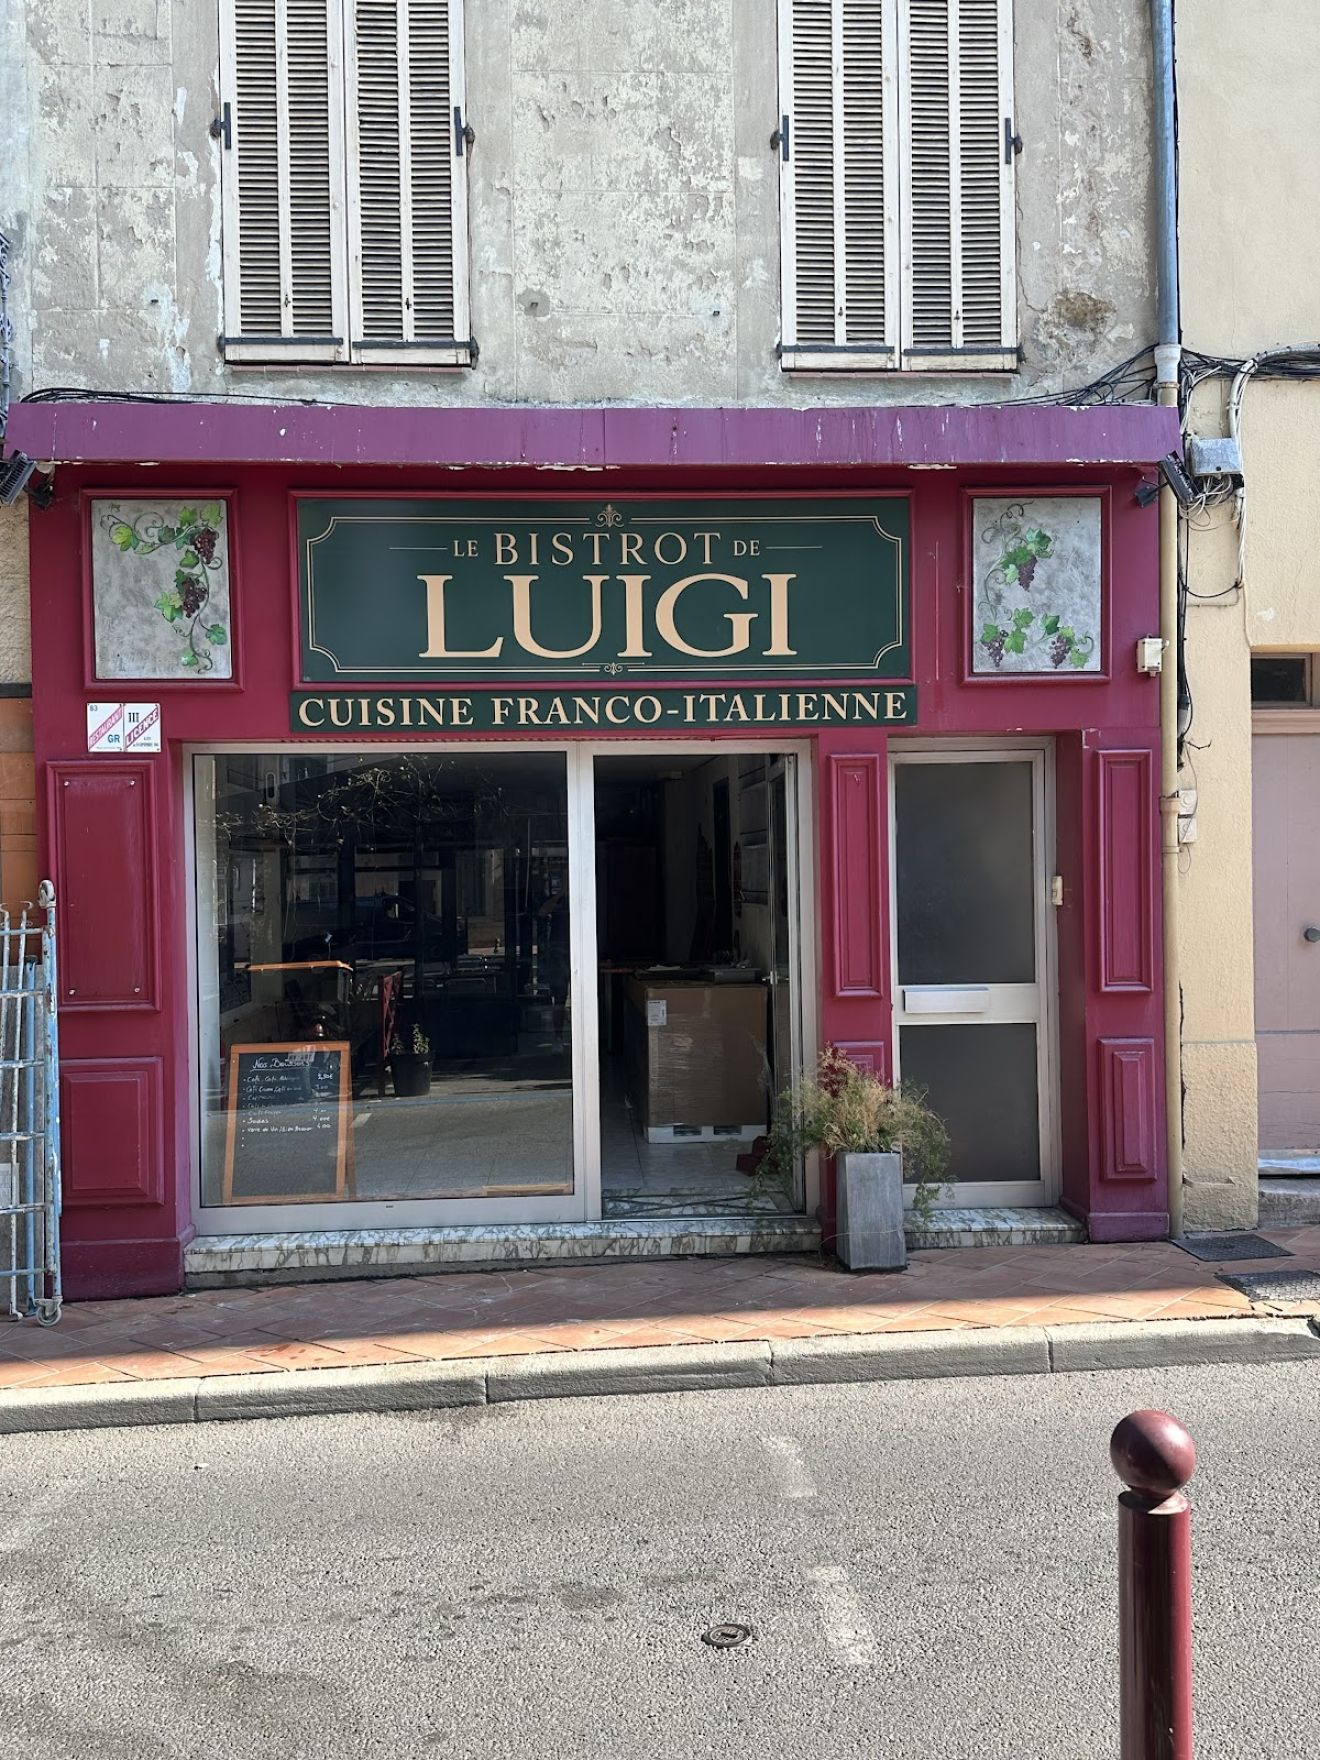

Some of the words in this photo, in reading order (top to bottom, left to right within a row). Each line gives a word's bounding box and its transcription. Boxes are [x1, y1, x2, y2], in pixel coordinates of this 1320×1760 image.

[454, 540, 478, 557] LE
[495, 532, 721, 565] BISTROT
[734, 540, 760, 557] DE
[417, 573, 797, 659] LUIGI
[128, 712, 140, 723] III
[298, 698, 474, 727] CUISINE
[492, 692, 908, 725] FRANCO-ITALIENNE
[107, 734, 120, 744] GR
[127, 709, 158, 746] LICENCE
